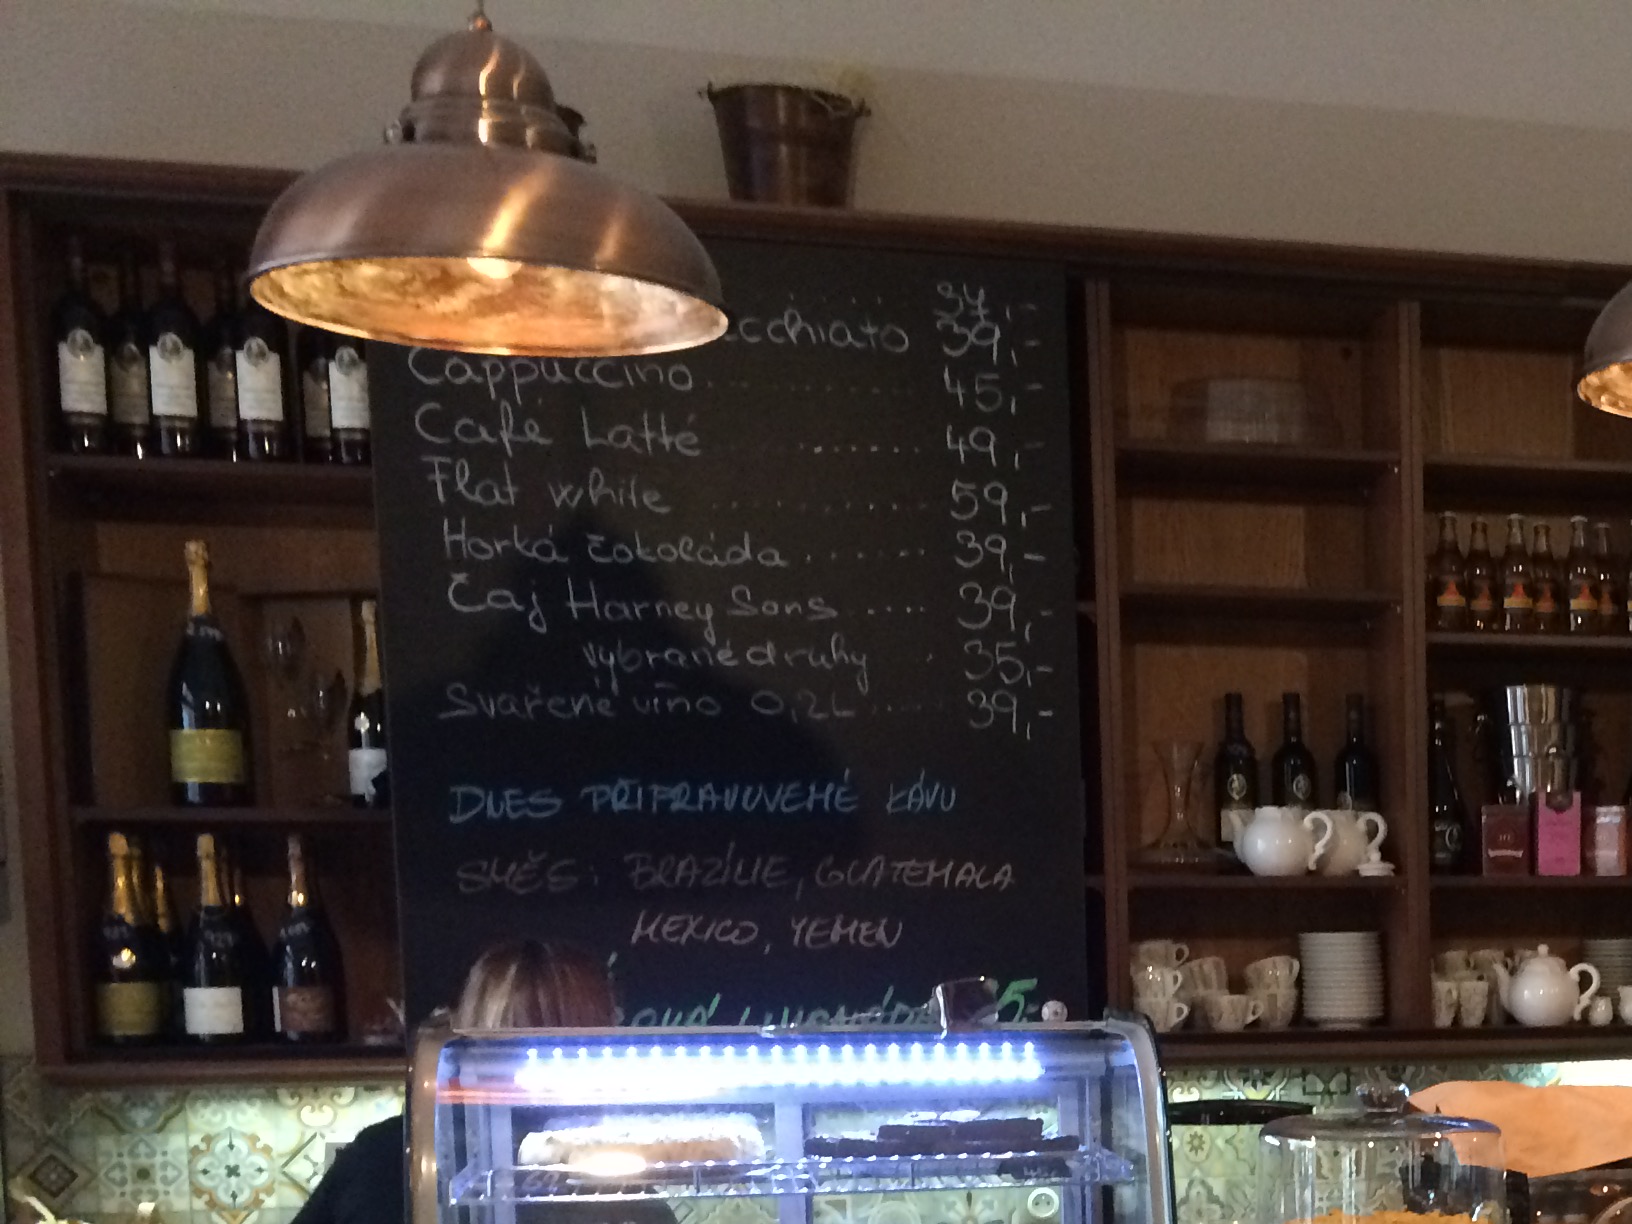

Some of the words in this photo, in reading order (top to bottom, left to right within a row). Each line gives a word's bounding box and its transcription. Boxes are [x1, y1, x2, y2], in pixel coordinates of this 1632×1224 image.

[725, 308, 910, 353] cchiato
[407, 345, 694, 403] Cappuccino
[422, 455, 518, 506] Flat
[550, 468, 671, 514] white
[442, 516, 569, 564] Horká
[446, 572, 548, 635] Čaj
[566, 578, 717, 645] Harney
[726, 585, 839, 622] Sons
